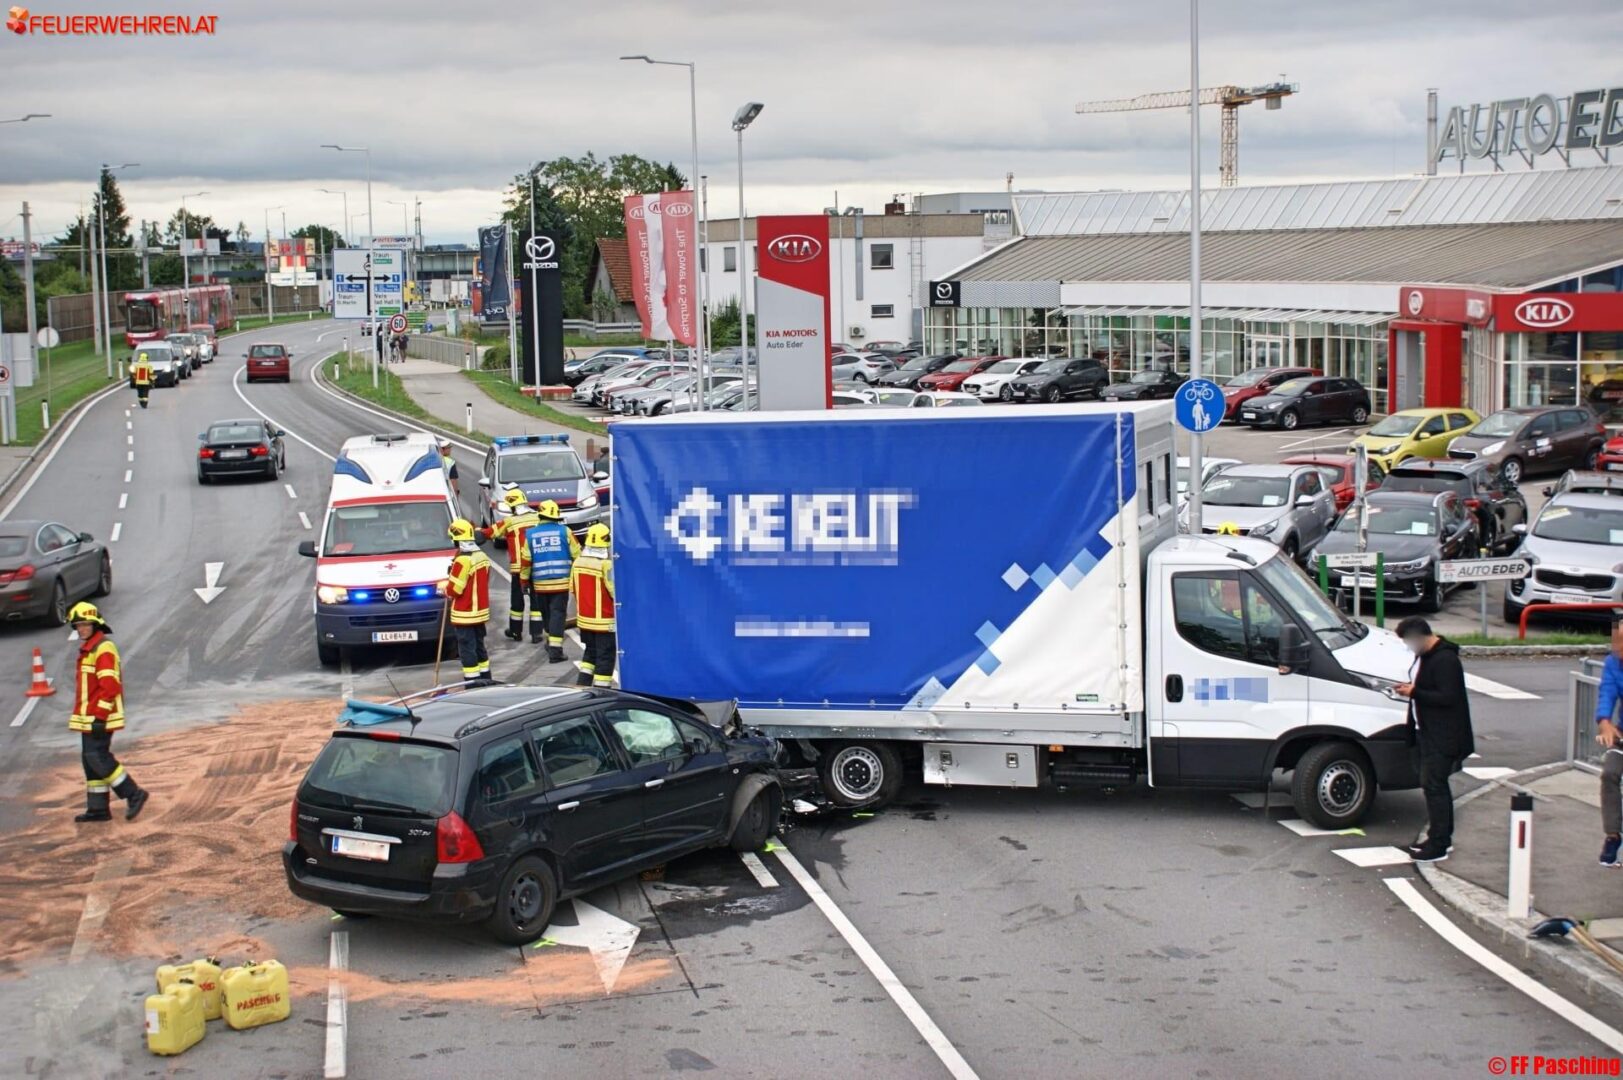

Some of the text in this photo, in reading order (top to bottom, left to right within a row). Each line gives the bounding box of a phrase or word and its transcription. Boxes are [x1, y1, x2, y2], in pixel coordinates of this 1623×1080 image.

[1436, 93, 1561, 162] AUTO
[778, 241, 813, 256] KIA
[1525, 304, 1564, 320] KIA
[394, 318, 404, 329] 60
[766, 329, 818, 338] KIA MOTORS
[766, 340, 804, 349] Auto Eder
[526, 487, 568, 495] POLIZEI
[532, 536, 561, 548] LFB
[1458, 565, 1491, 577] AUTO
[1491, 563, 1526, 575] EDER
